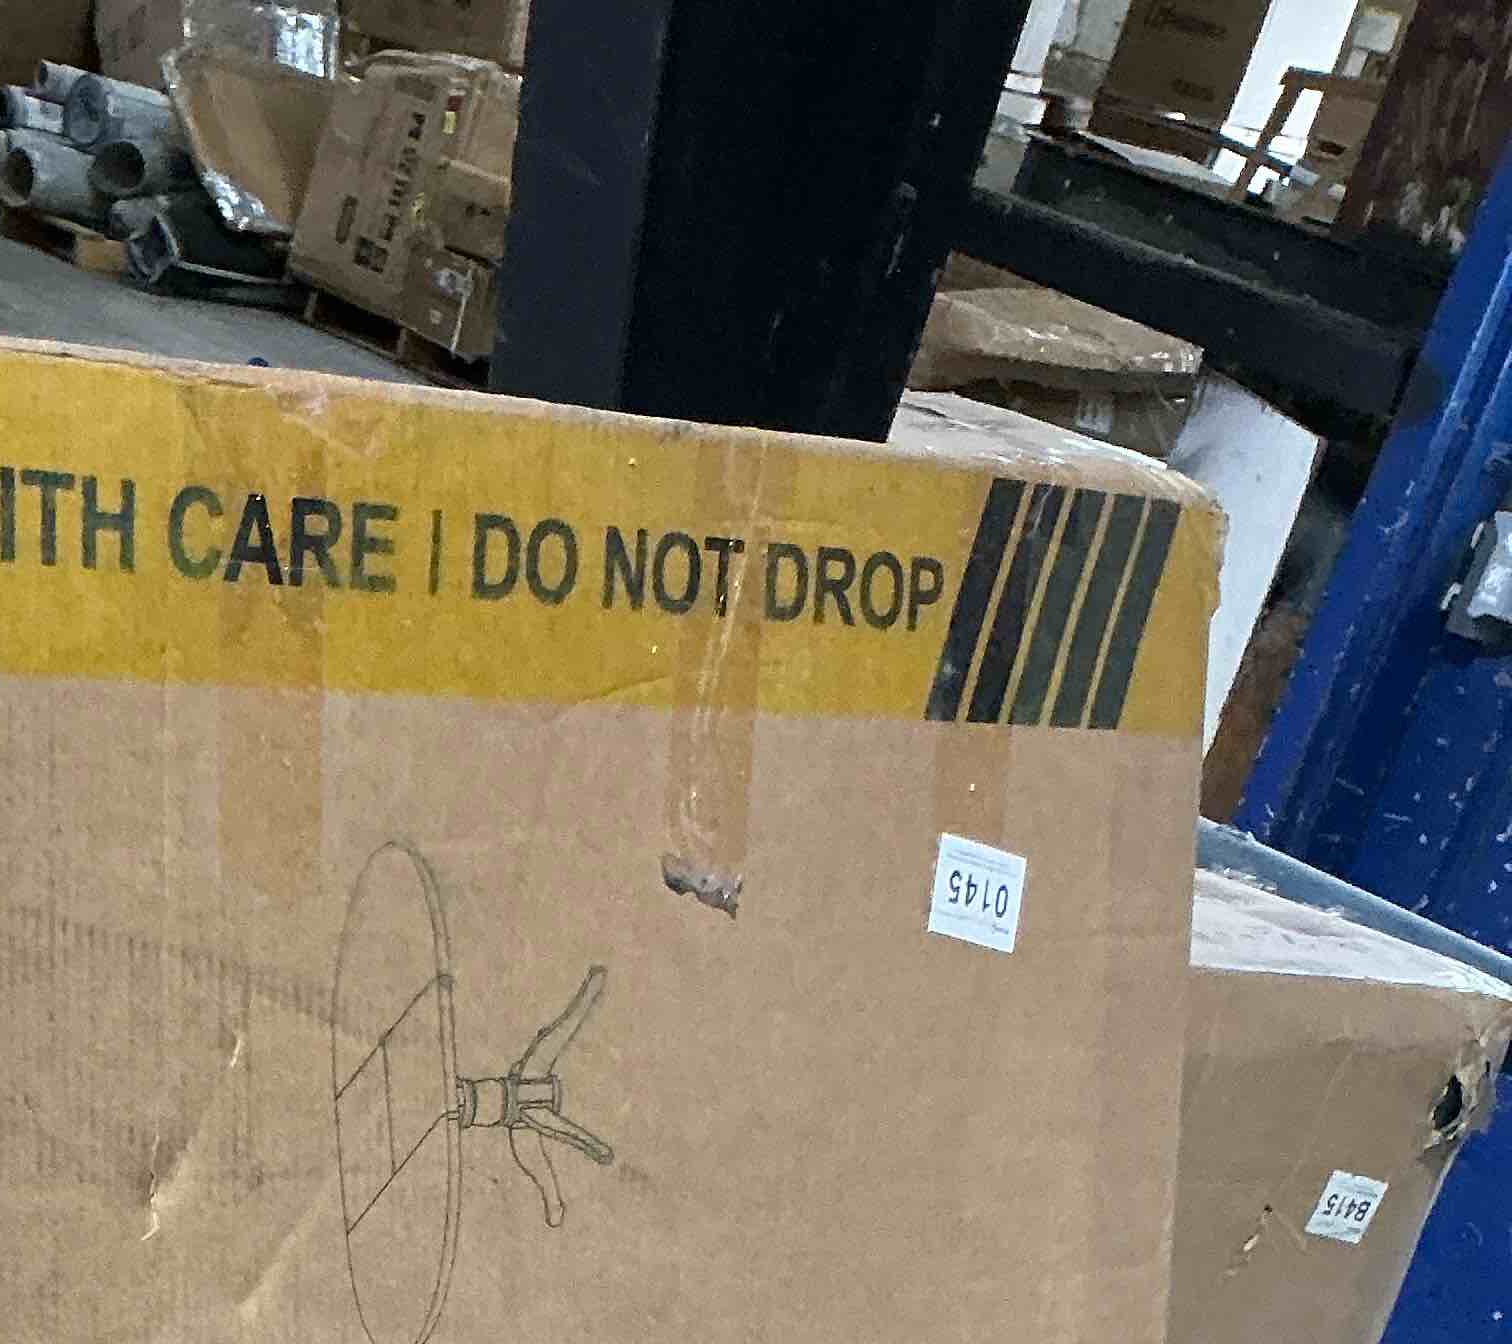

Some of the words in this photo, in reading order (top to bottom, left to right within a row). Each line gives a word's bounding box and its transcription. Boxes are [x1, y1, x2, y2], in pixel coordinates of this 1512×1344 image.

[167, 484, 400, 595] CARE
[472, 512, 579, 606] DO
[600, 524, 746, 618] NOT
[763, 541, 947, 634] DROP
[947, 869, 1009, 919] 0145
